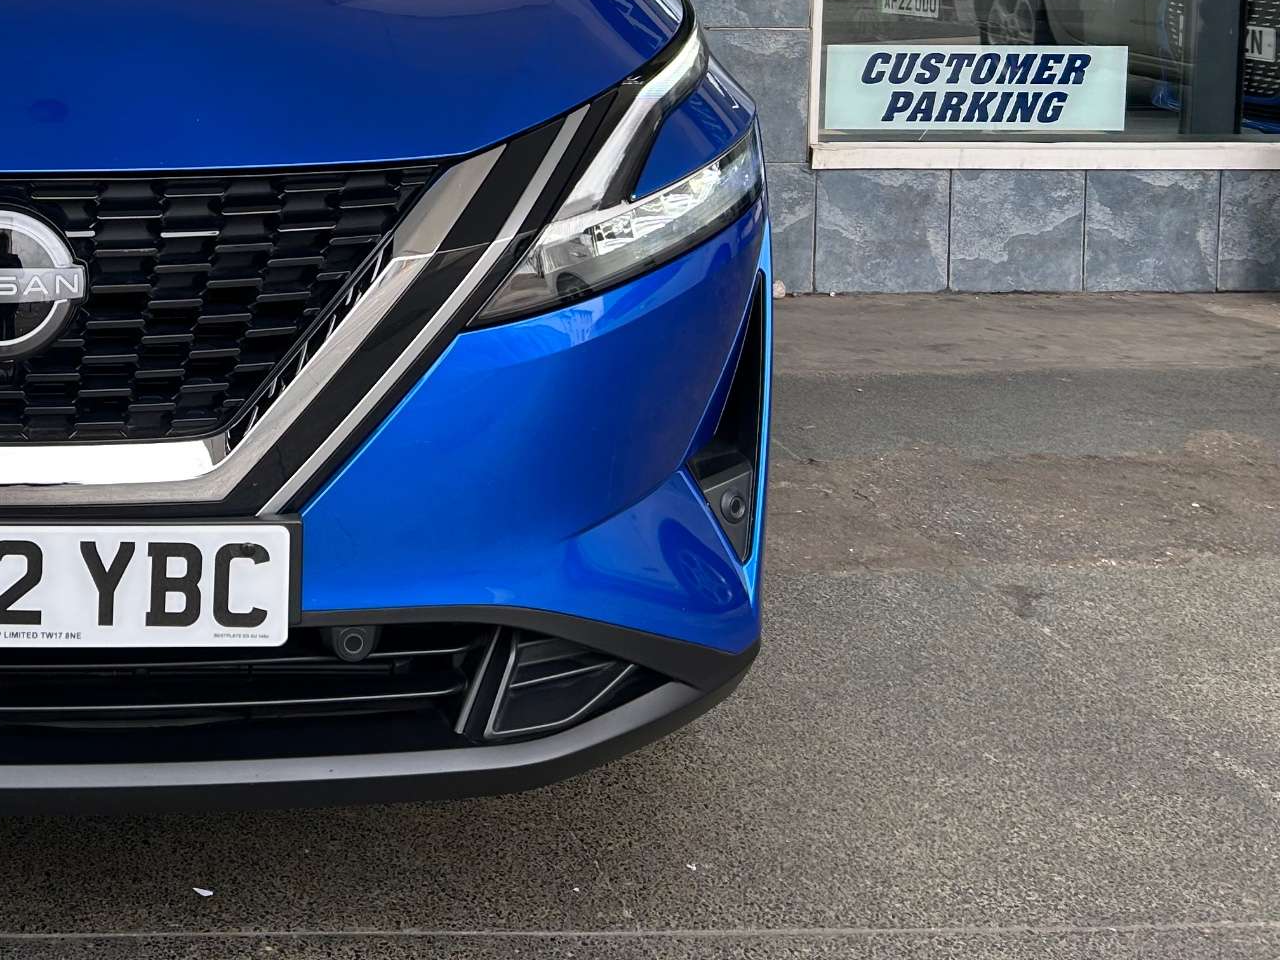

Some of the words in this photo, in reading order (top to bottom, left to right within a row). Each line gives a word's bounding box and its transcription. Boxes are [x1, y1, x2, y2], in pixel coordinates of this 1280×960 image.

[860, 52, 1092, 85] CUSTOMER
[881, 91, 1069, 123] PARKING
[80, 541, 271, 628] YBC
[41, 632, 62, 640] TW17
[65, 632, 82, 640] 8NE
